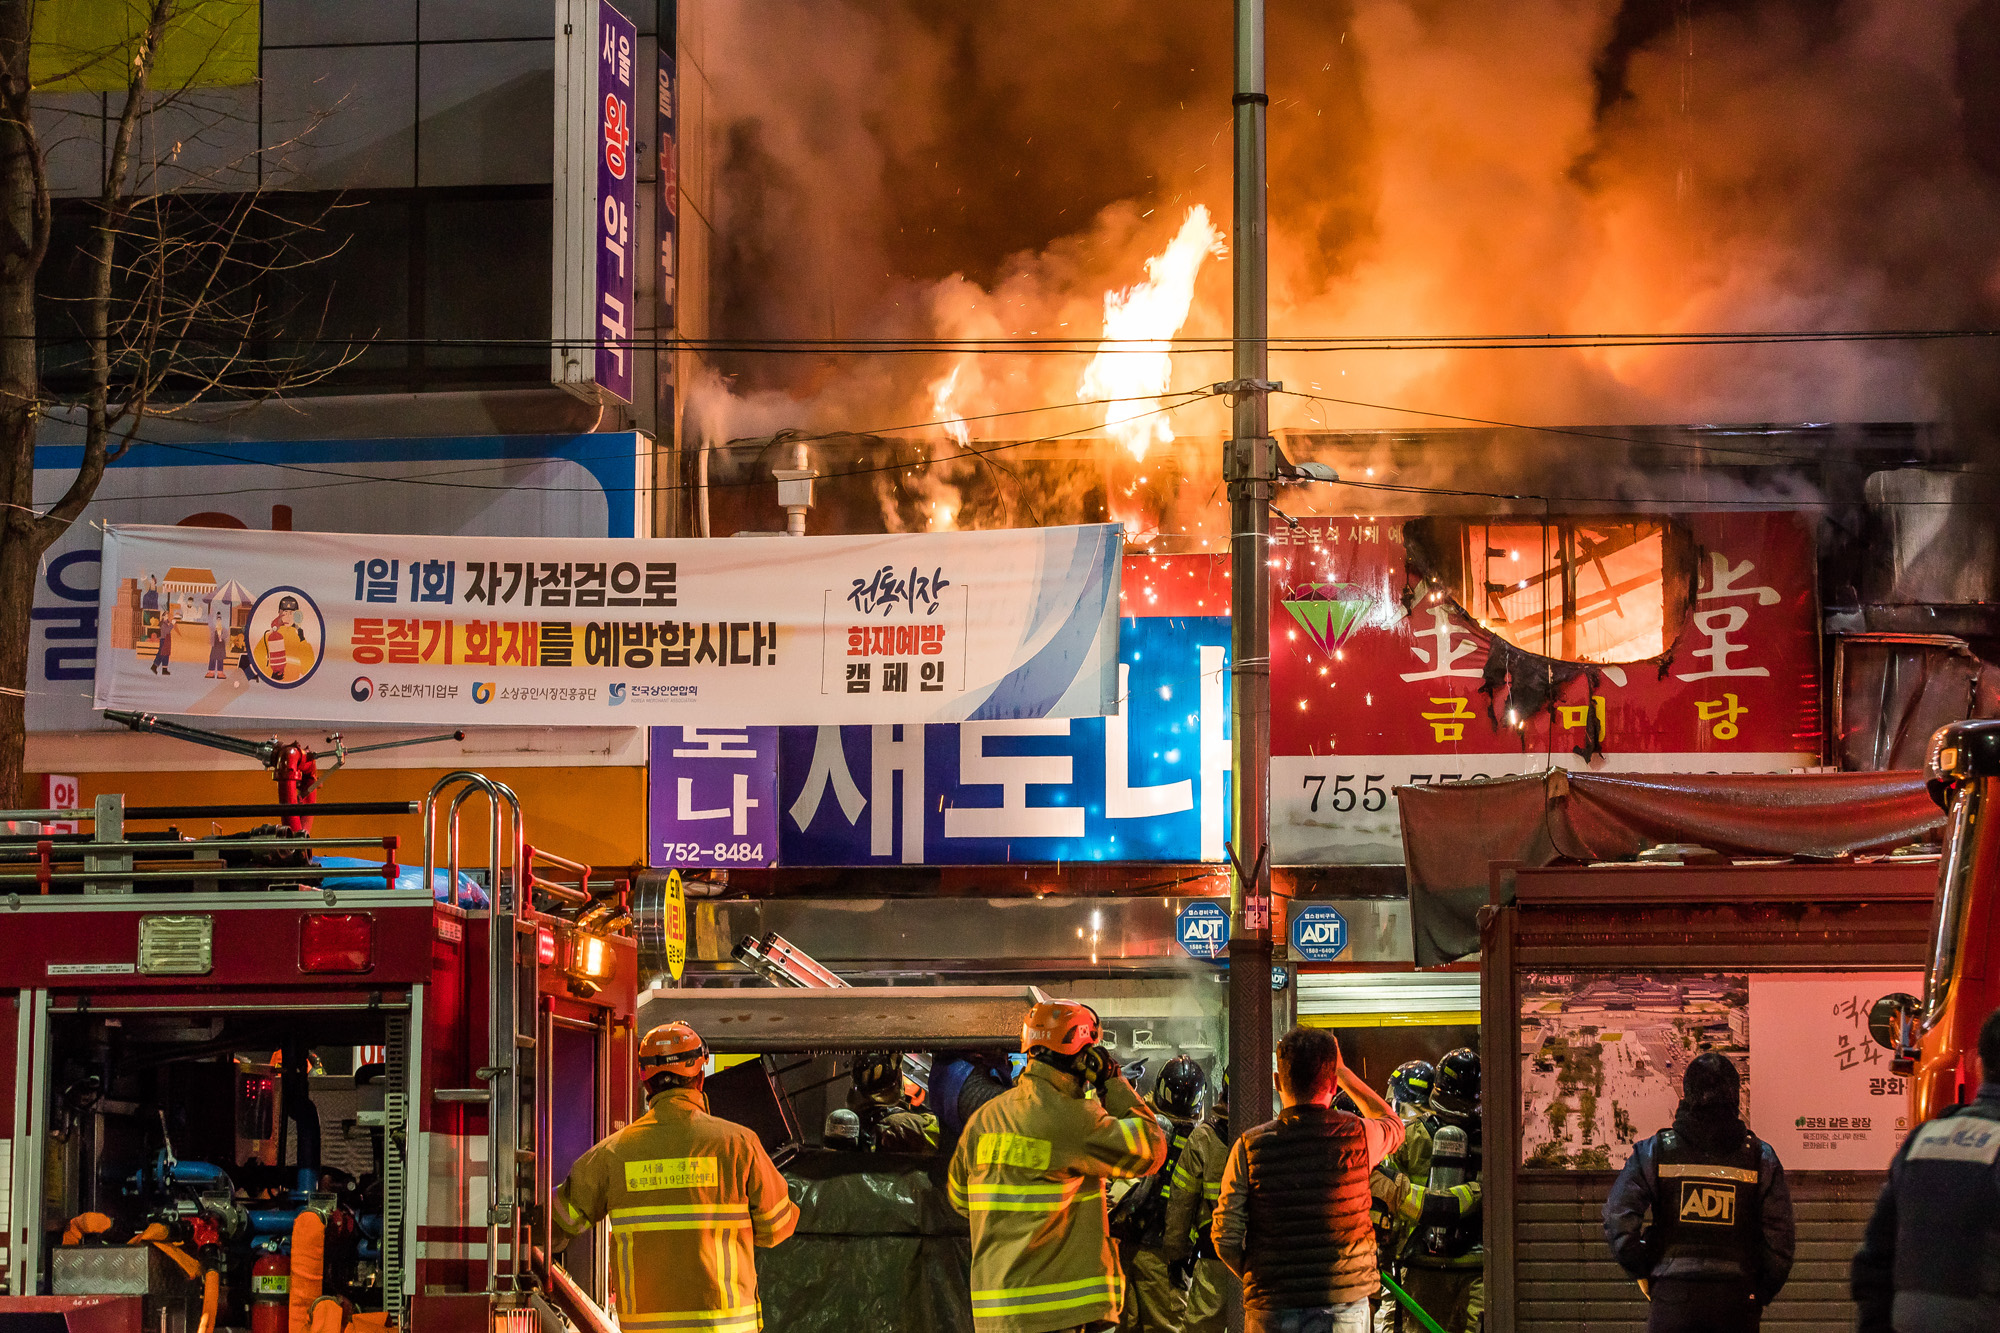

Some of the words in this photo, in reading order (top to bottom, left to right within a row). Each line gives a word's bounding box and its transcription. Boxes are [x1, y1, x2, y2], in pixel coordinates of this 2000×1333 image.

[1348, 525, 1379, 545] 시계
[354, 558, 400, 603] 1일
[409, 559, 455, 605] 1회
[463, 561, 677, 607] 자가점검으로
[847, 565, 950, 617] 전통시장
[351, 617, 454, 665] 동절기
[464, 619, 574, 667] 화재를
[584, 620, 777, 669] 예방합시다!
[847, 625, 946, 656] 화재예방
[378, 683, 459, 699] 중소벤처기업부
[500, 687, 597, 701] 소상공인시장진흥공단
[631, 685, 698, 697] 전국상인연합회
[663, 843, 764, 862] 752-8484
[1184, 920, 1222, 939] ADT
[1301, 924, 1339, 943] ADT
[1834, 1034, 1883, 1071] 문화
[1806, 1117, 1826, 1128] 공원
[1829, 1117, 1849, 1128] 같은
[1851, 1117, 1871, 1128] 광장
[1681, 1188, 1735, 1219] ADT
